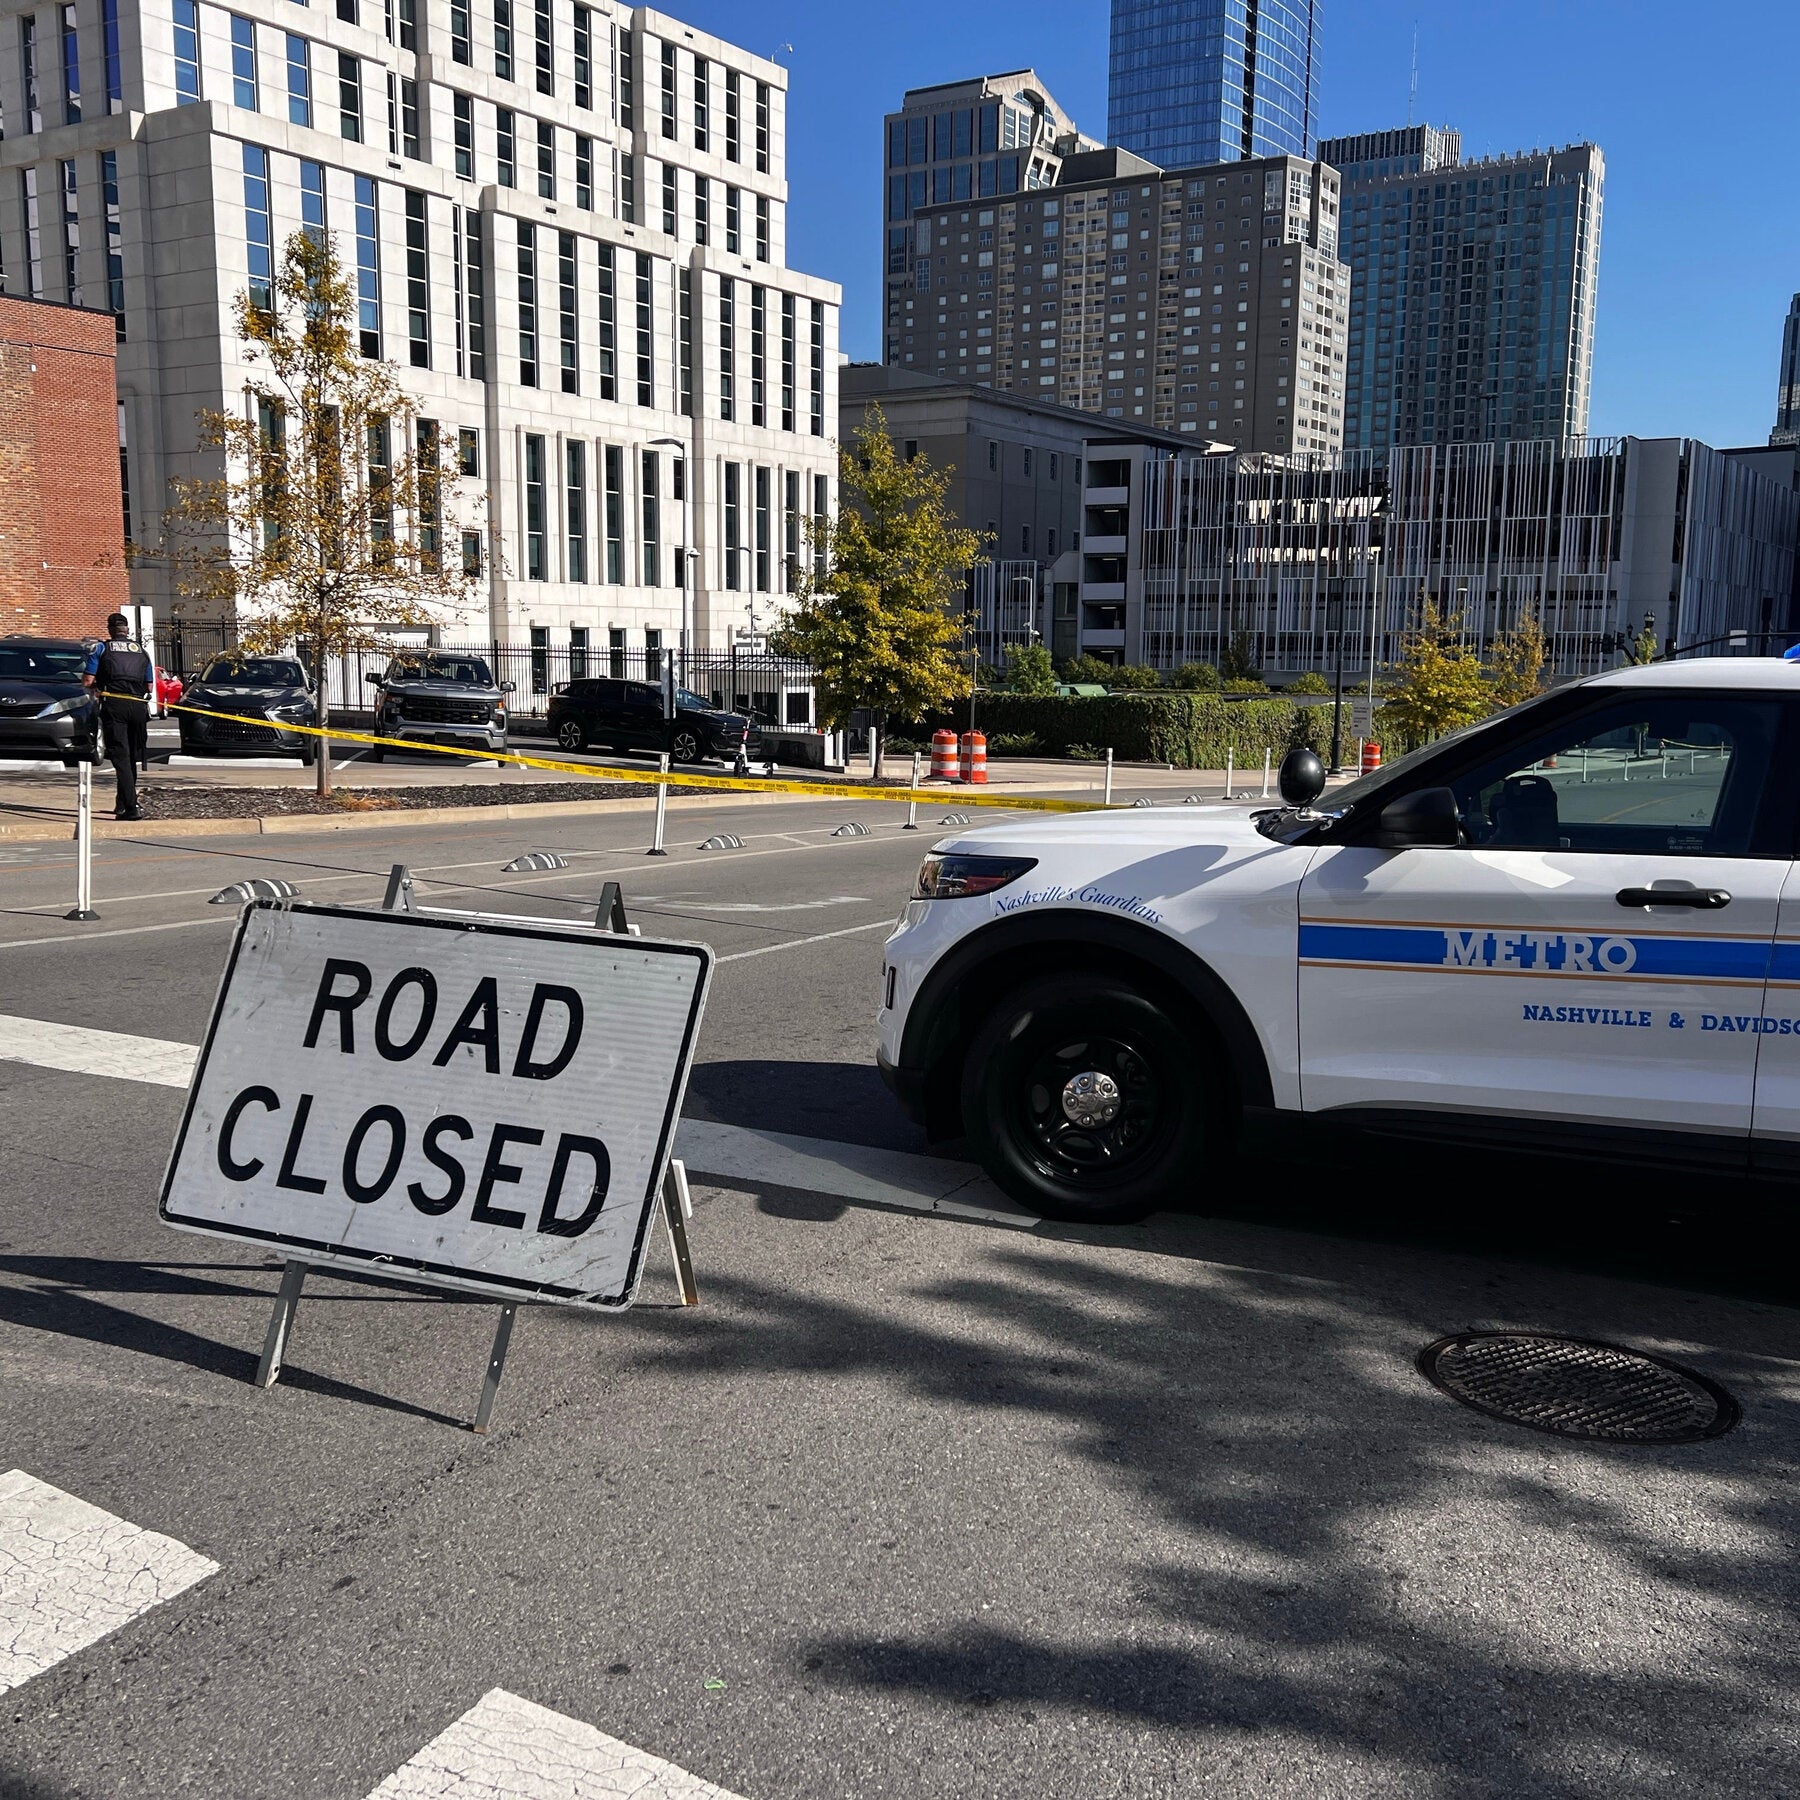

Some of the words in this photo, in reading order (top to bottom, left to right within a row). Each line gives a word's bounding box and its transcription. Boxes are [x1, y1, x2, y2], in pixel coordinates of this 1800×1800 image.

[994, 886, 1077, 917] Nashville's
[1079, 886, 1163, 925] Guardians
[1443, 931, 1637, 974] METRO
[303, 957, 585, 1081] ROAD
[1523, 1004, 1652, 1027] NASHVILLE
[1669, 1012, 1685, 1029] &
[217, 1084, 611, 1239] CLOSED
